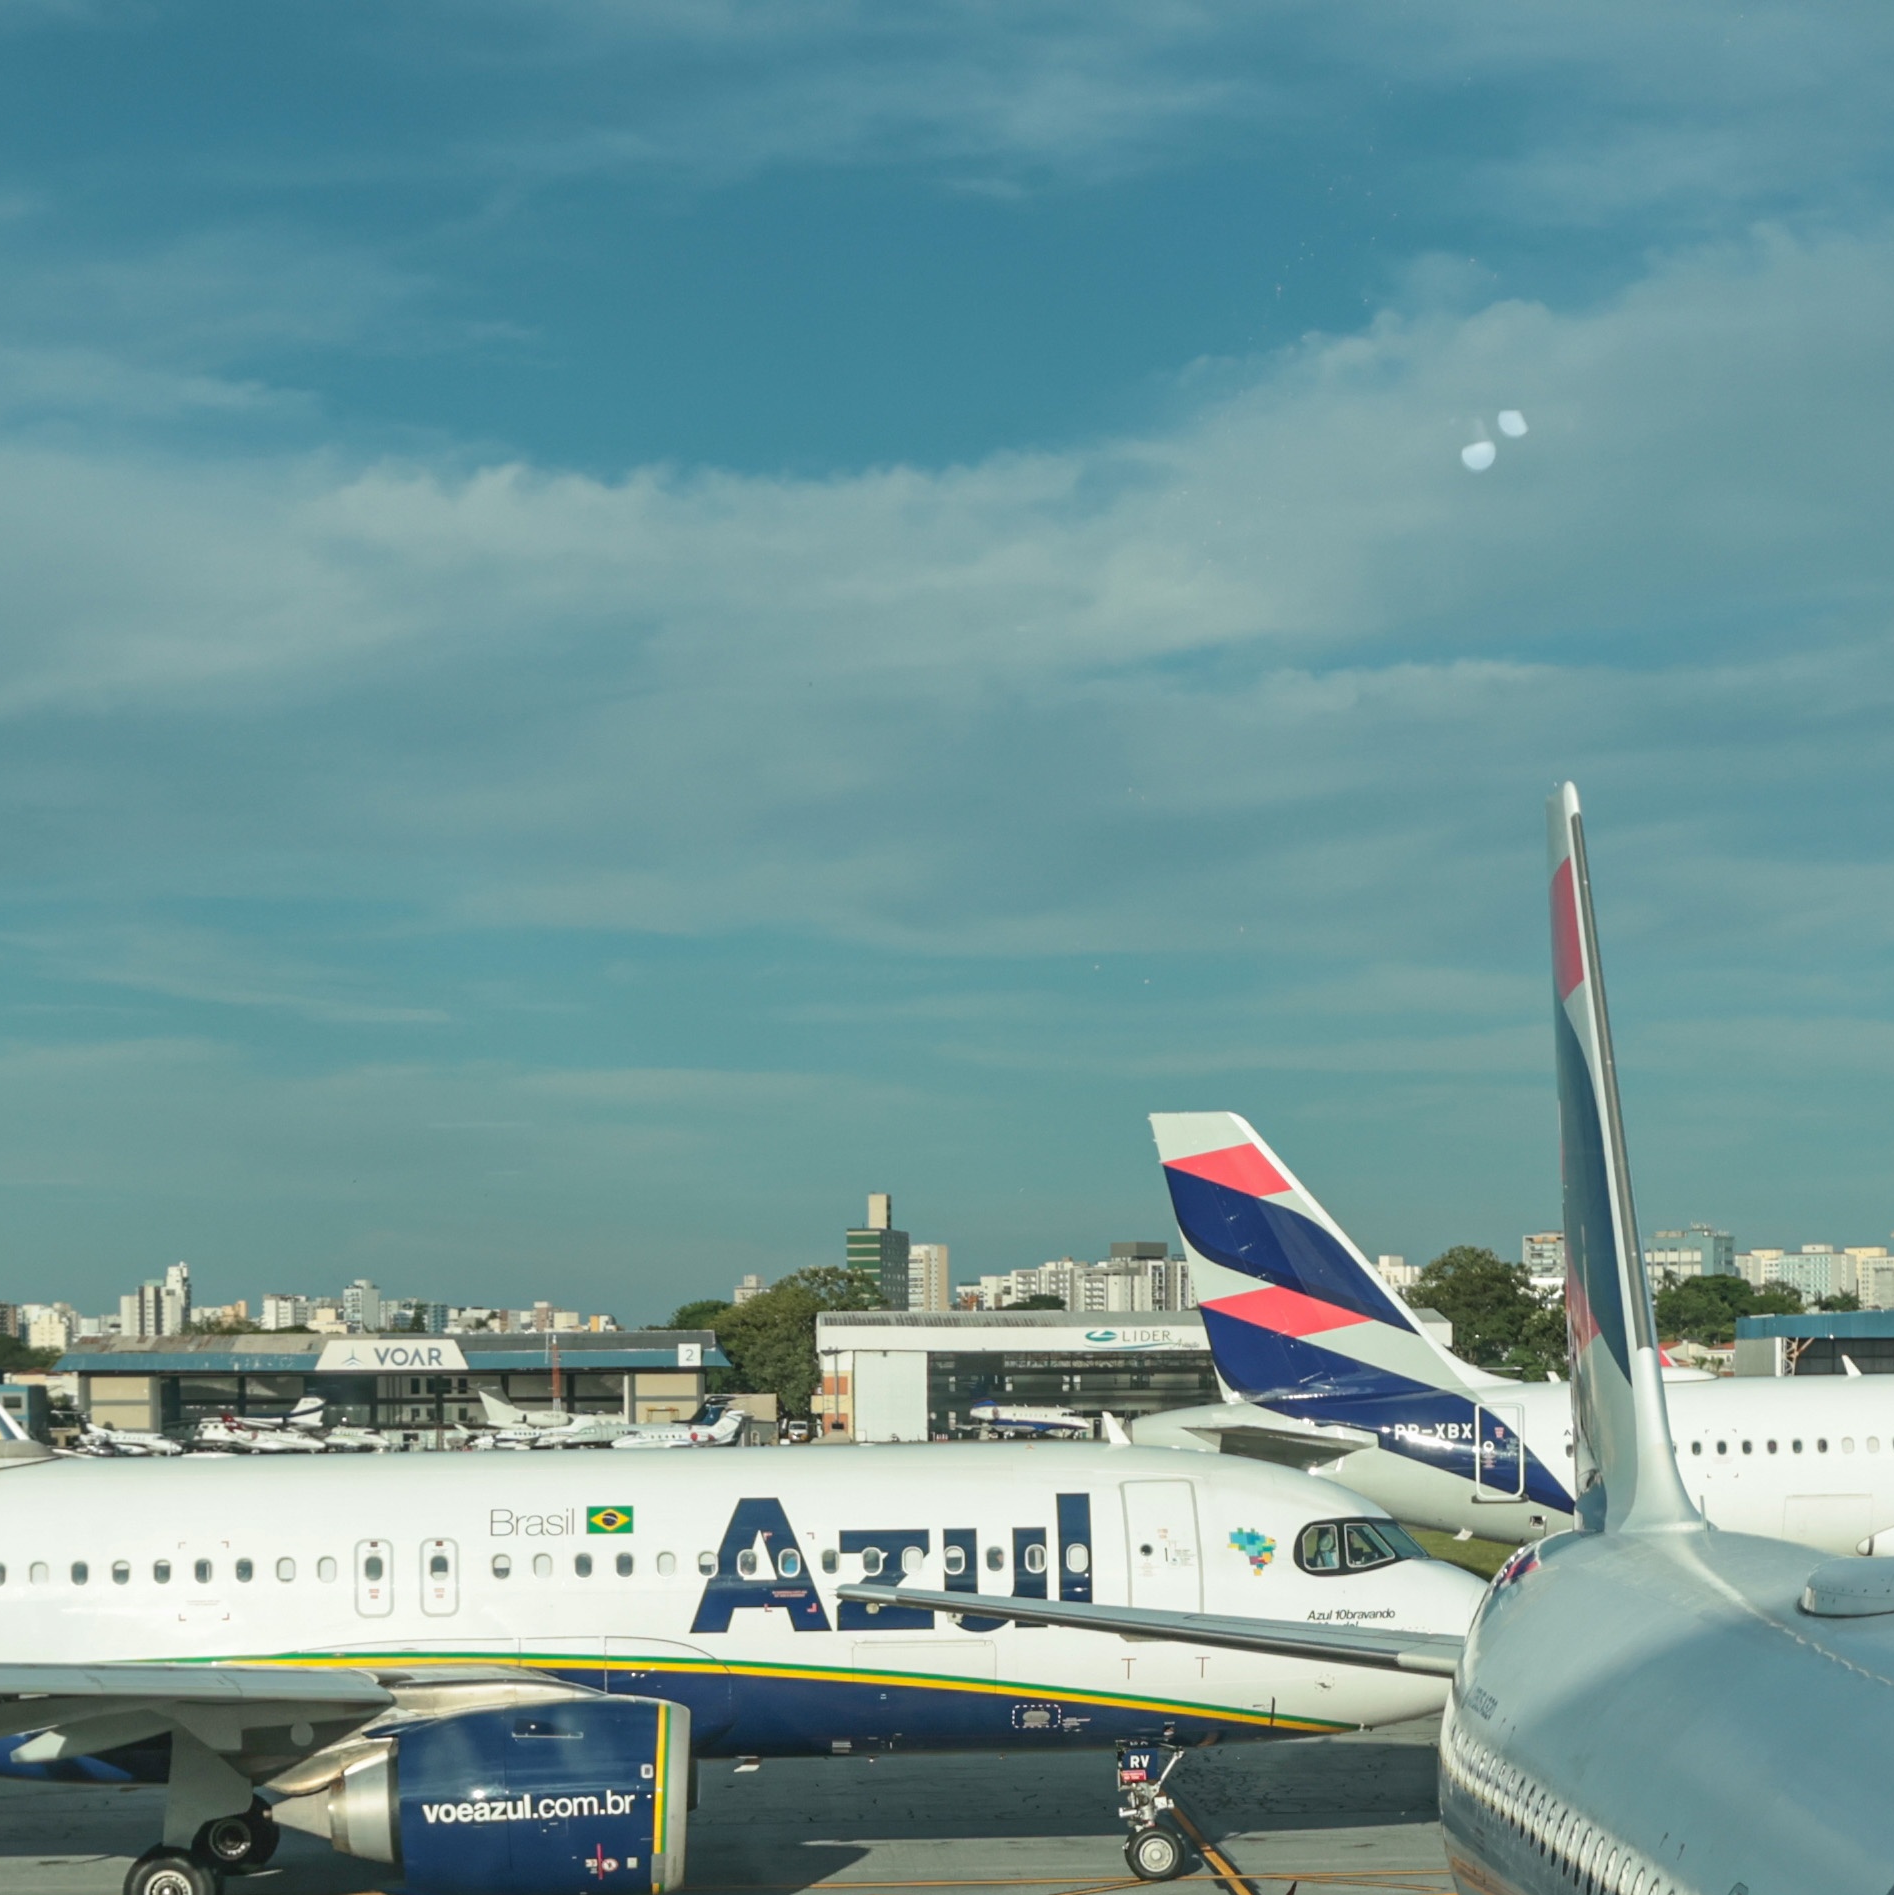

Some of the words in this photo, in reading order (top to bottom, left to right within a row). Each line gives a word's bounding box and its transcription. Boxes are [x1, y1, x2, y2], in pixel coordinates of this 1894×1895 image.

[1122, 1330, 1173, 1342] LIDER
[373, 1347, 443, 1366] VOAR
[684, 1348, 695, 1362] 2
[490, 1508, 575, 1536] Brasil
[689, 1493, 1094, 1633] Azul
[1307, 1610, 1333, 1620] Azul
[1335, 1608, 1395, 1620] 10bravando
[1129, 1755, 1150, 1768] RV
[422, 1789, 636, 1824] voeazul.com.br
